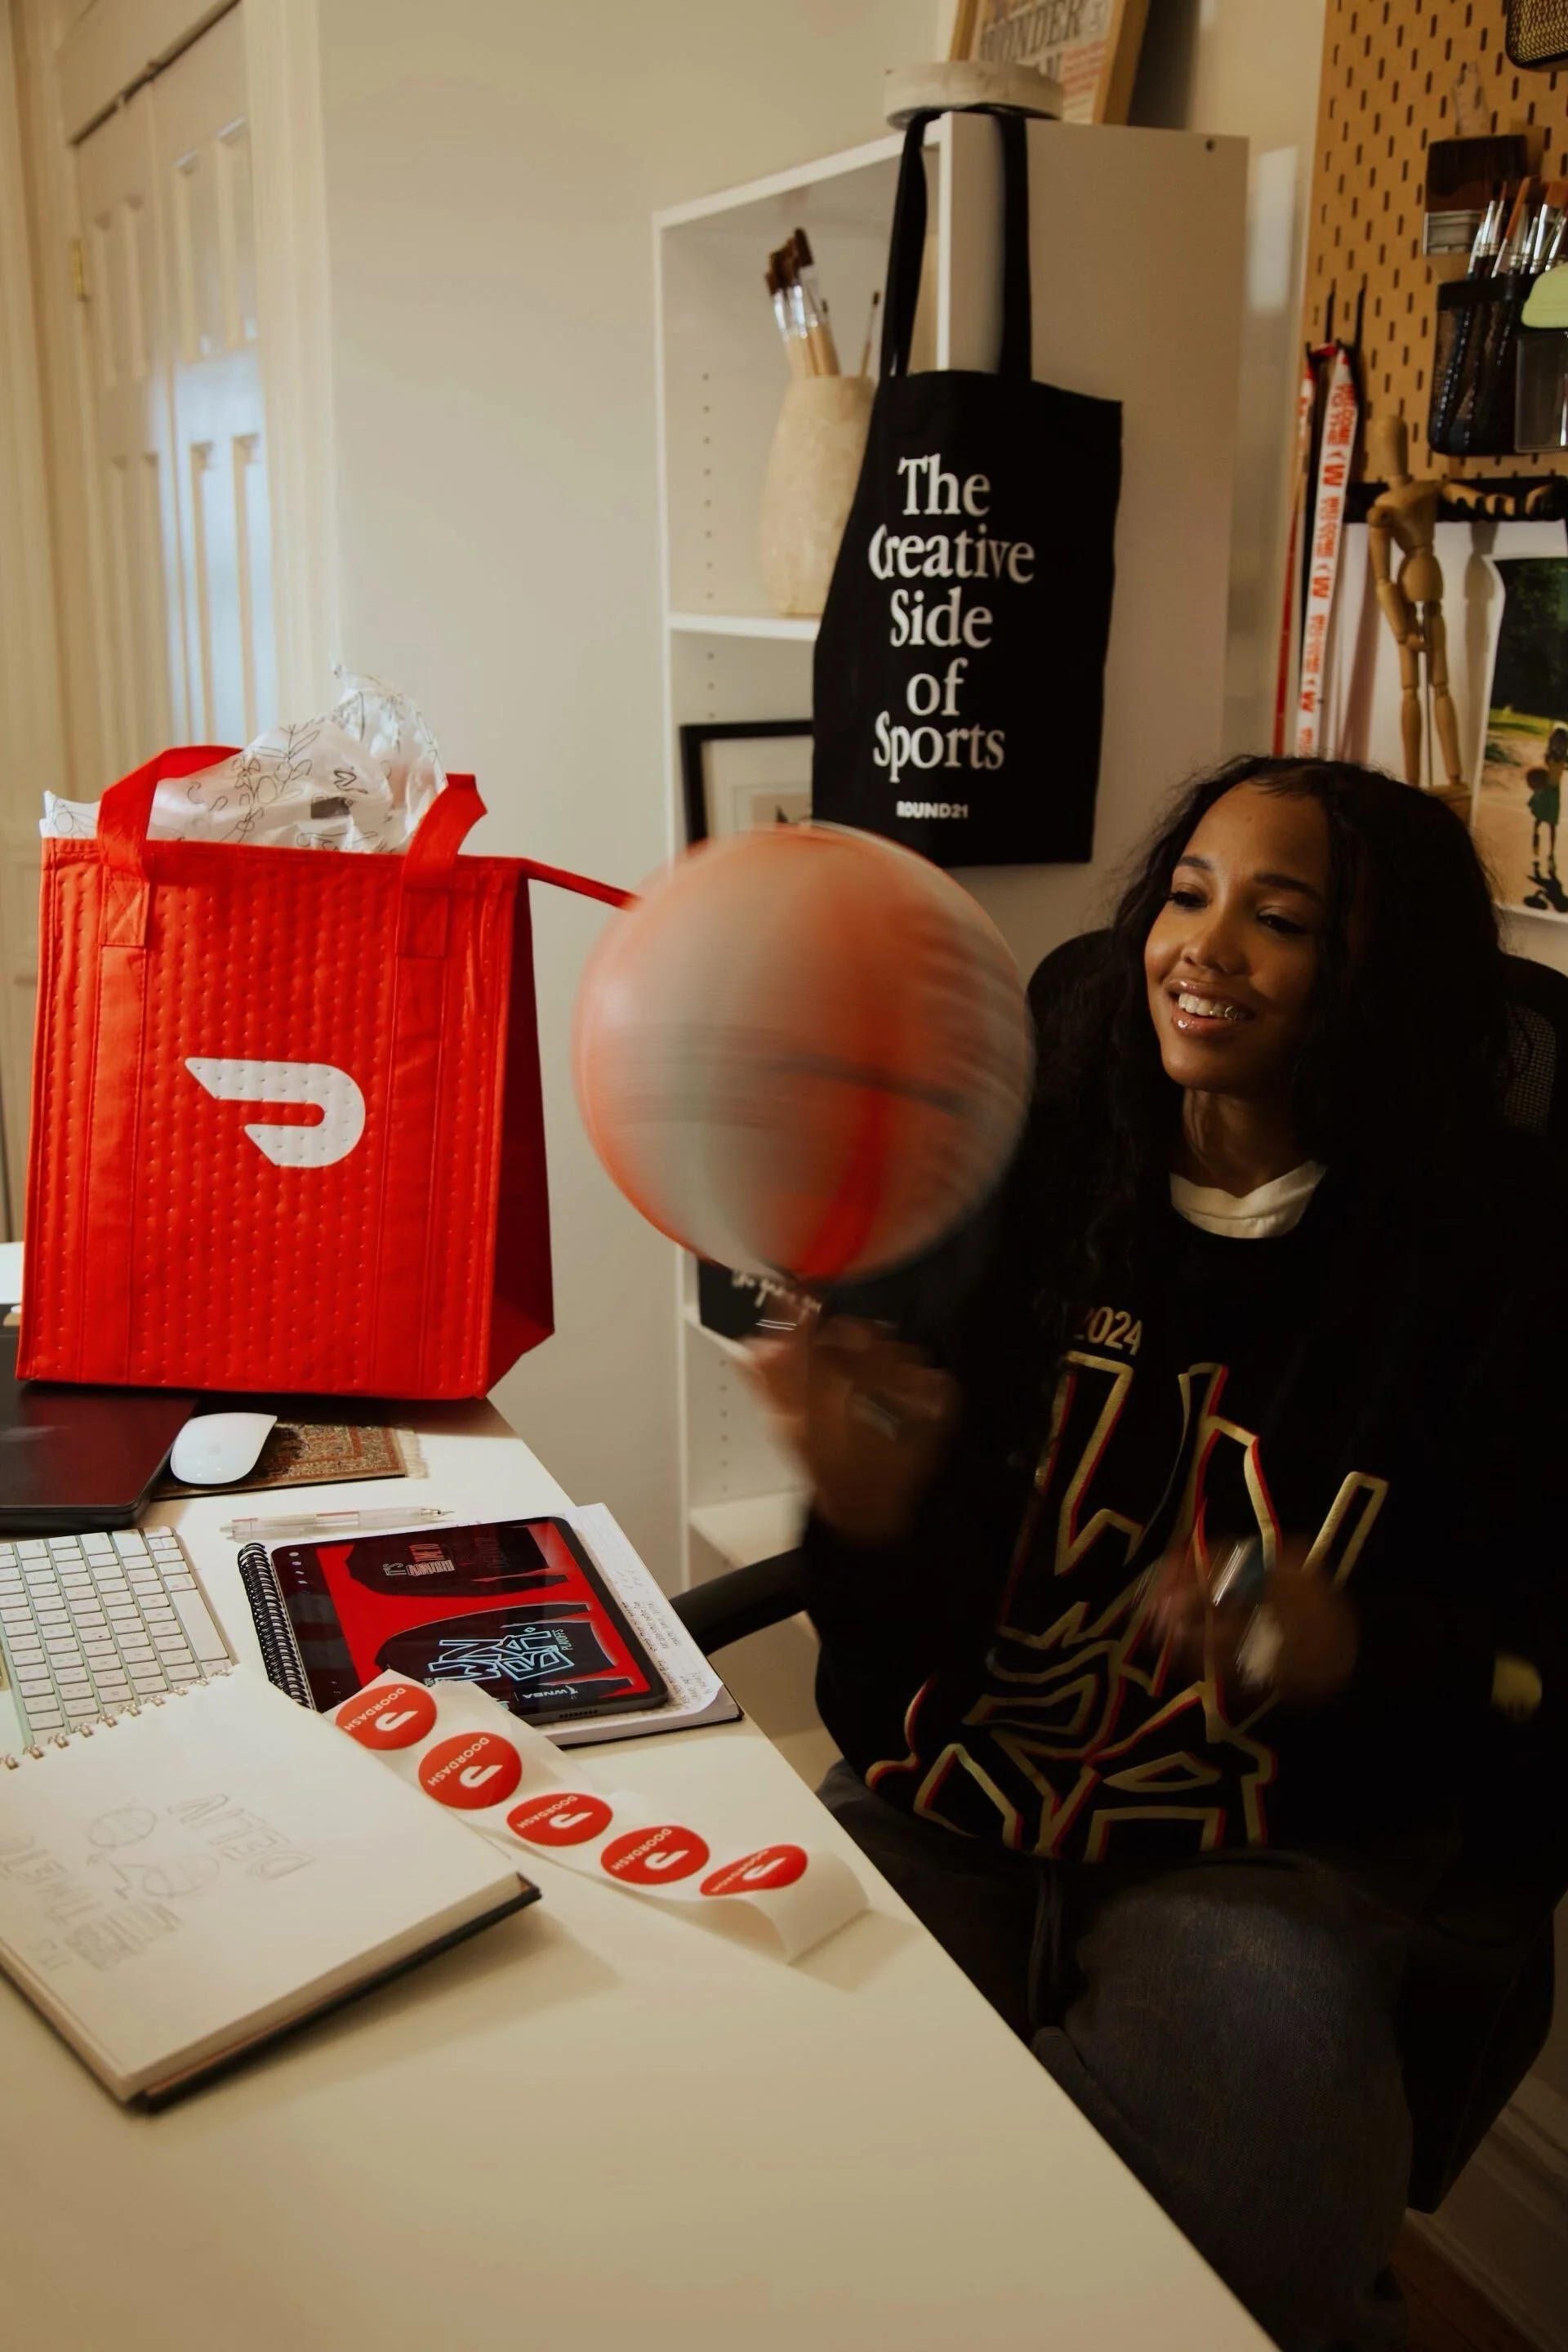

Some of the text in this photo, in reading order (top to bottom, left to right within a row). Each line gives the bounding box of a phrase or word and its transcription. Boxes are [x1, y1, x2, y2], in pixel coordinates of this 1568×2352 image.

[898, 453, 990, 516] The
[1322, 465, 1345, 487] W
[868, 523, 1035, 584] Creative
[1312, 577, 1330, 598] W
[890, 586, 993, 648] Side
[906, 657, 969, 716] of
[873, 711, 1005, 782] Sports
[897, 801, 969, 818] ROUND21
[344, 1686, 407, 1731] DOORDASH
[523, 1688, 568, 1699] WNBA
[428, 1736, 490, 1786] DOORDASH
[516, 1795, 578, 1829] DOORDASH
[611, 1828, 673, 1871] DOORDASH
